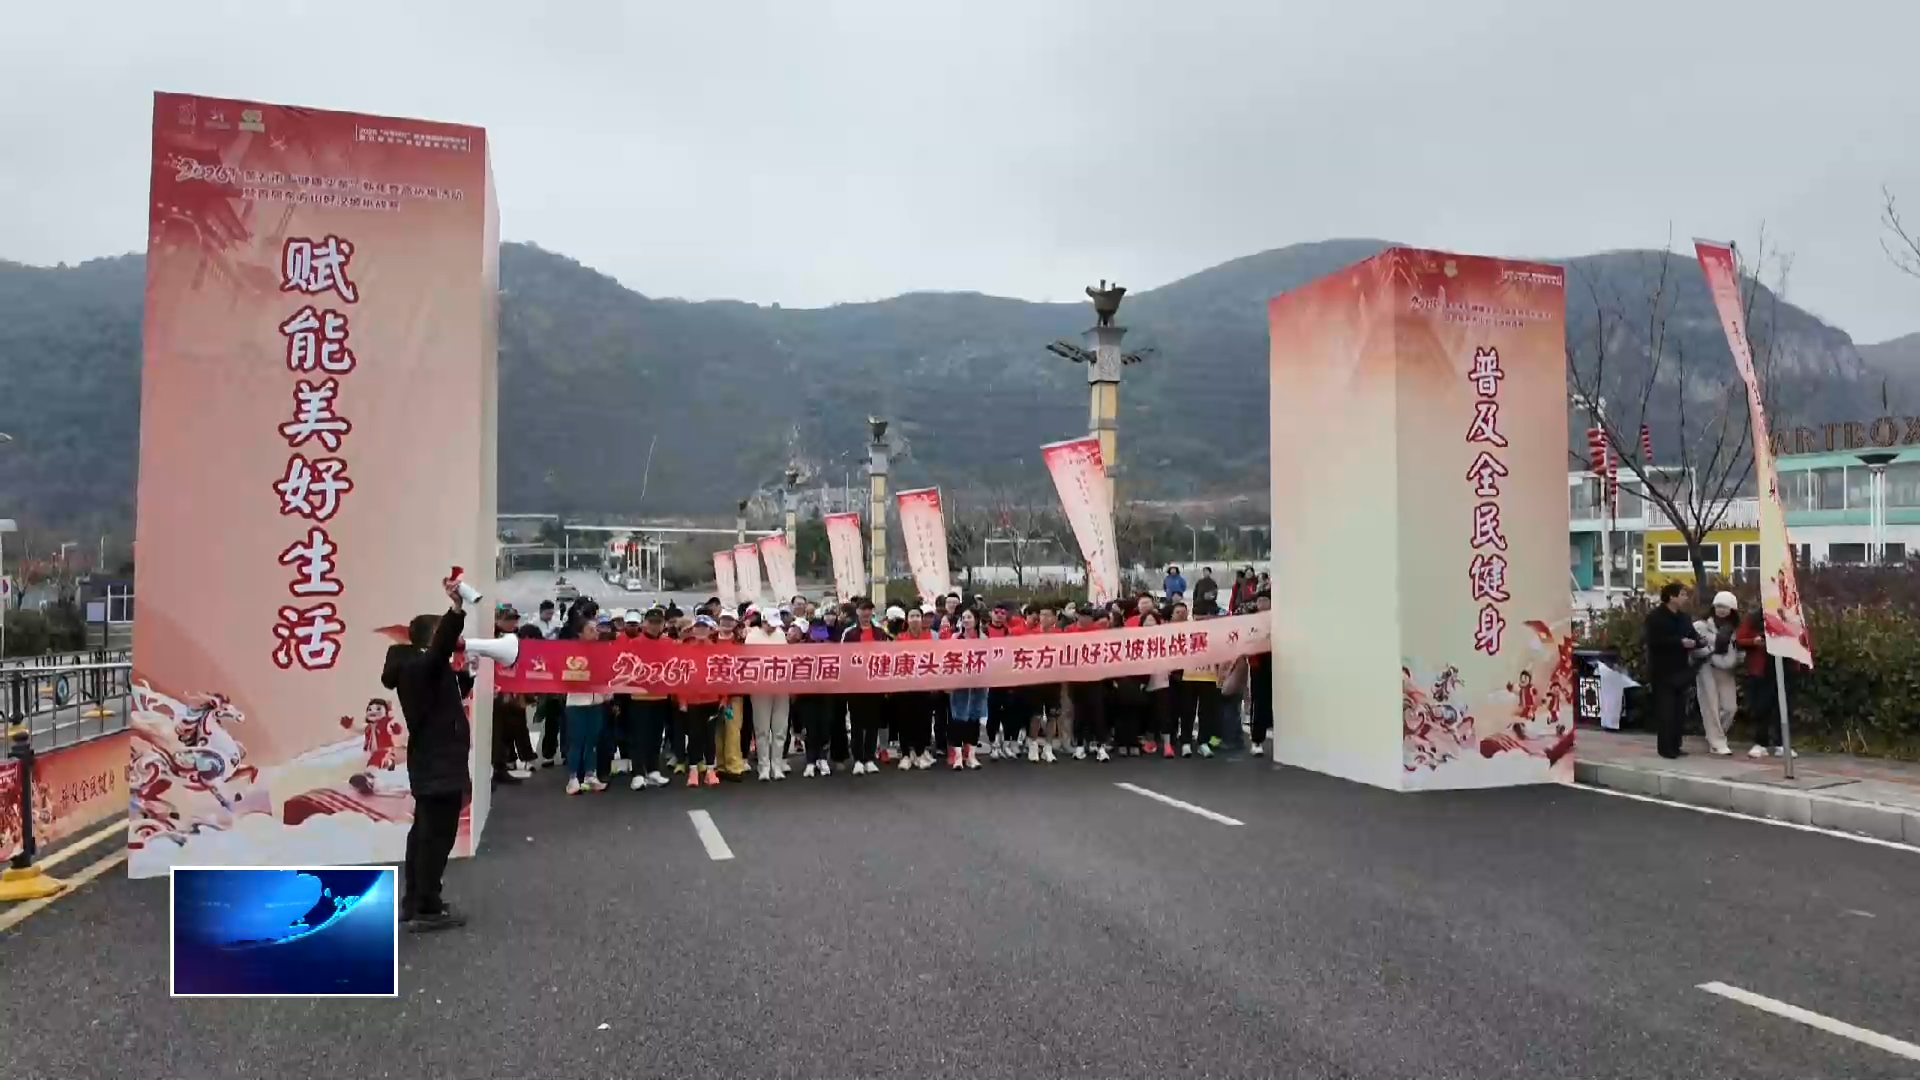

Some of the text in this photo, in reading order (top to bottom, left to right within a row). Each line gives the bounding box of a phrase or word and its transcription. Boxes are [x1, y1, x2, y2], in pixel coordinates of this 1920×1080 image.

[273, 236, 358, 671] 赋能美好生活
[1466, 346, 1510, 655] 普及全民健身
